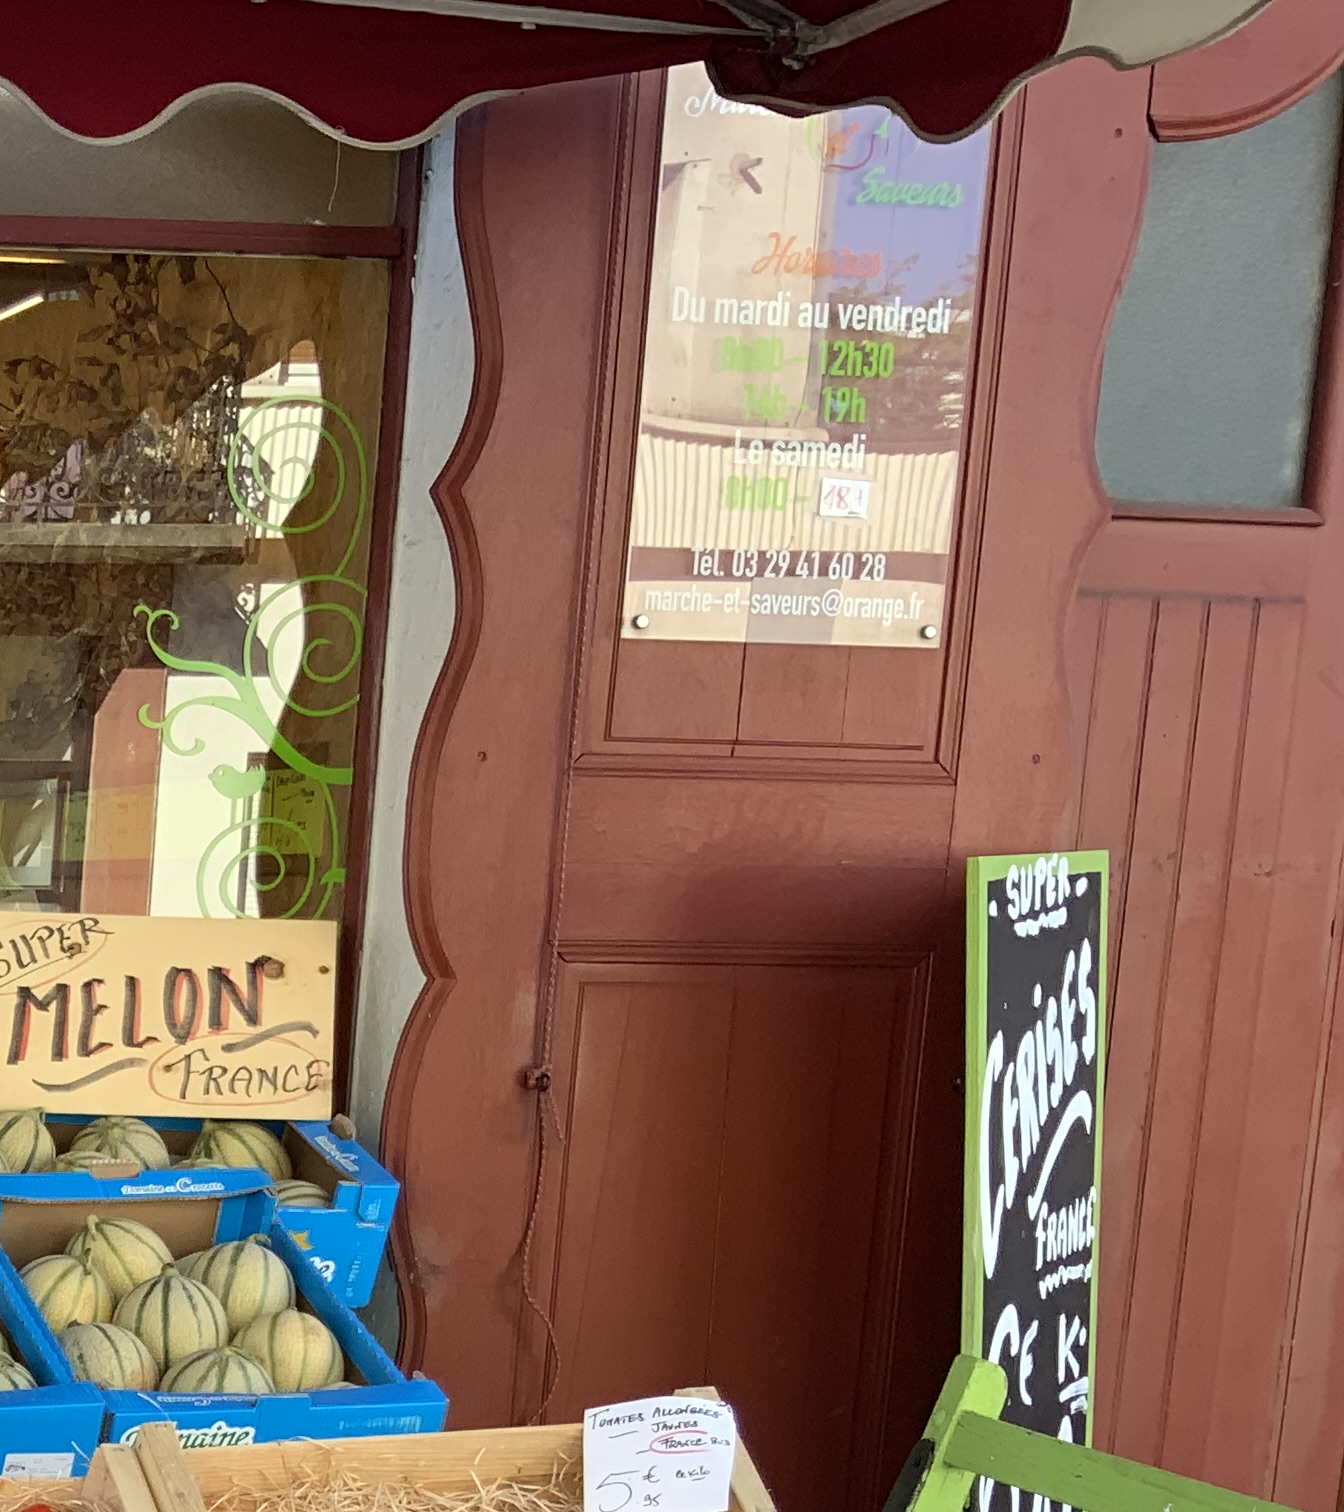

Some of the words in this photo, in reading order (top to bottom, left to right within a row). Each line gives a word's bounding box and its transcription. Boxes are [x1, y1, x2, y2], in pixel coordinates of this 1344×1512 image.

[671, 287, 706, 324] Du
[714, 289, 791, 328] mardi
[797, 295, 830, 330] au
[838, 298, 953, 335] vendredi
[819, 338, 895, 379] 12h30
[822, 385, 867, 424] 19h
[733, 429, 764, 465] Le
[771, 434, 868, 469] samedi
[691, 547, 725, 577] Tél.
[732, 549, 758, 578] 03
[764, 551, 790, 579] 29
[796, 552, 820, 580] 41
[828, 552, 854, 581] 60
[860, 553, 887, 582] 28
[644, 586, 925, 627] marche-et-saveurs@orange.fr
[1006, 853, 1071, 920] SUPER
[6, 957, 268, 1066] MELON
[162, 1047, 330, 1100] FRANCE
[979, 937, 1097, 1279] CERISES
[587, 1408, 646, 1430] TOMATES
[651, 1420, 700, 1434] JAUNES
[658, 1436, 708, 1450] FRANCE
[642, 1465, 661, 1484] €
